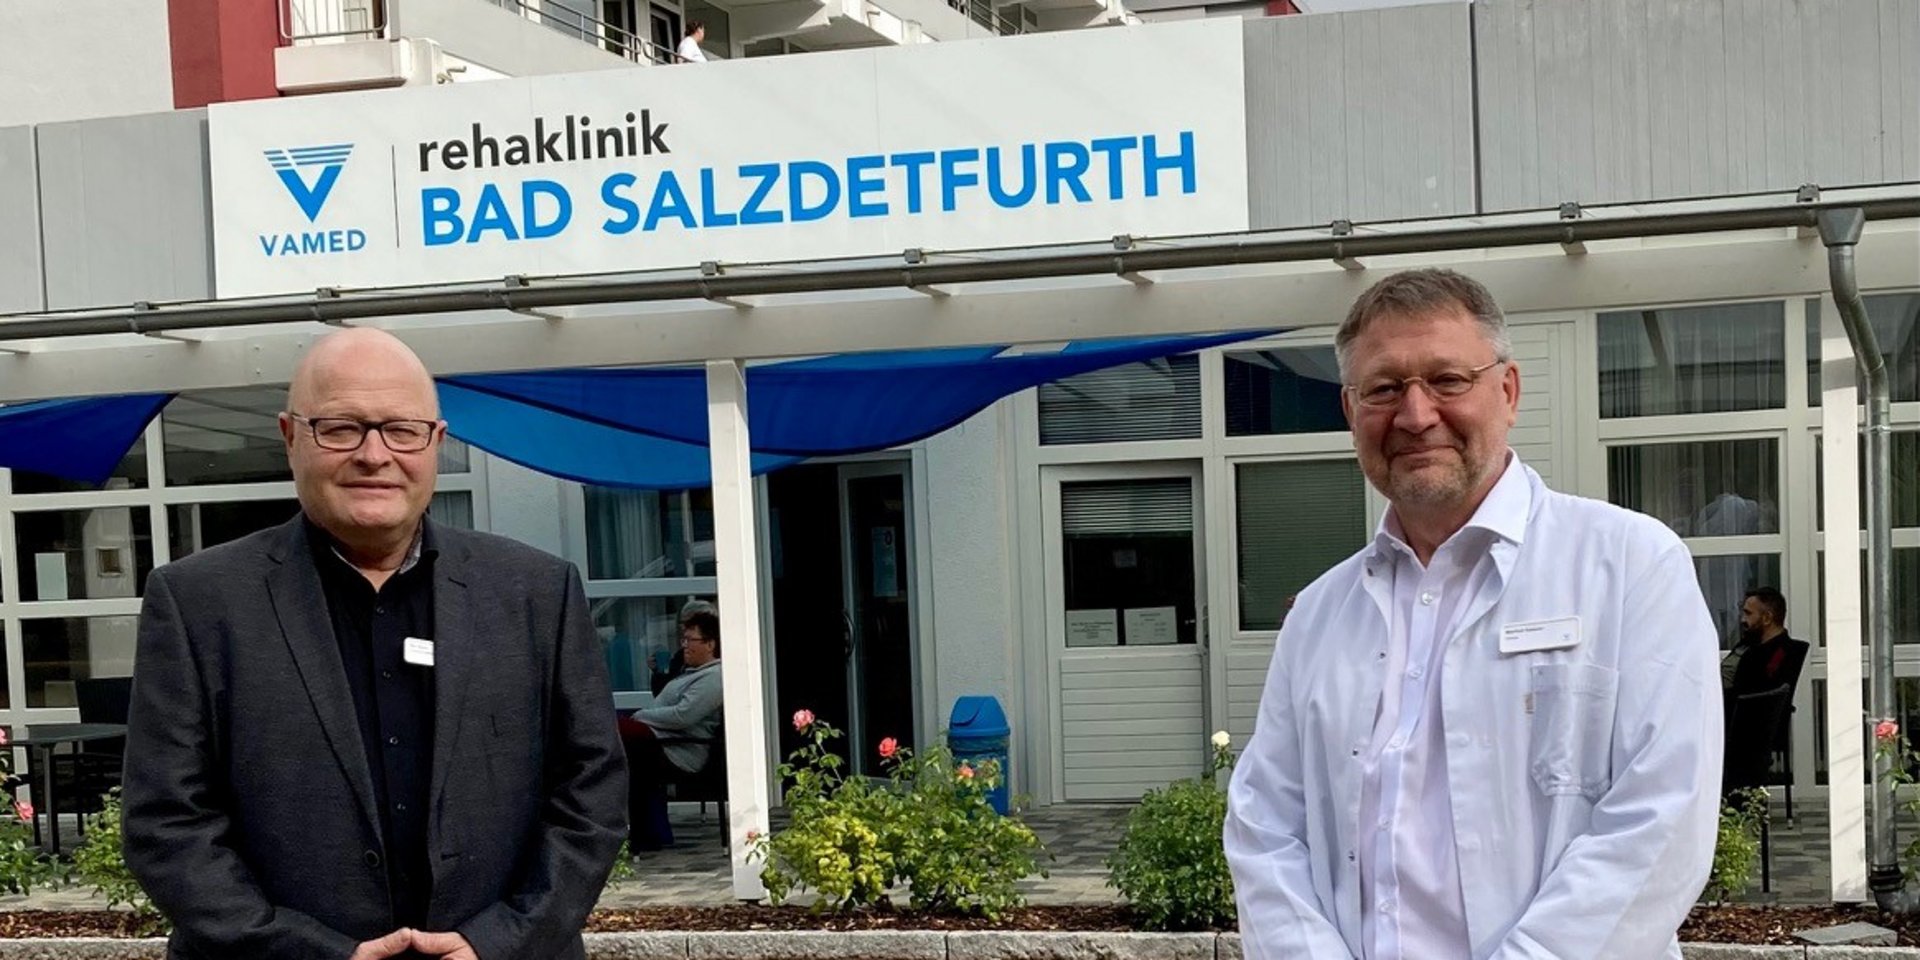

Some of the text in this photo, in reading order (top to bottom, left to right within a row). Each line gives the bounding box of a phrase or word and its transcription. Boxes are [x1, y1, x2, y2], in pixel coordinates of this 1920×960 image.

[418, 109, 670, 172] rehaklinik
[421, 130, 1197, 247] BAD SALZDETFURTH
[260, 229, 367, 257] VAMED
